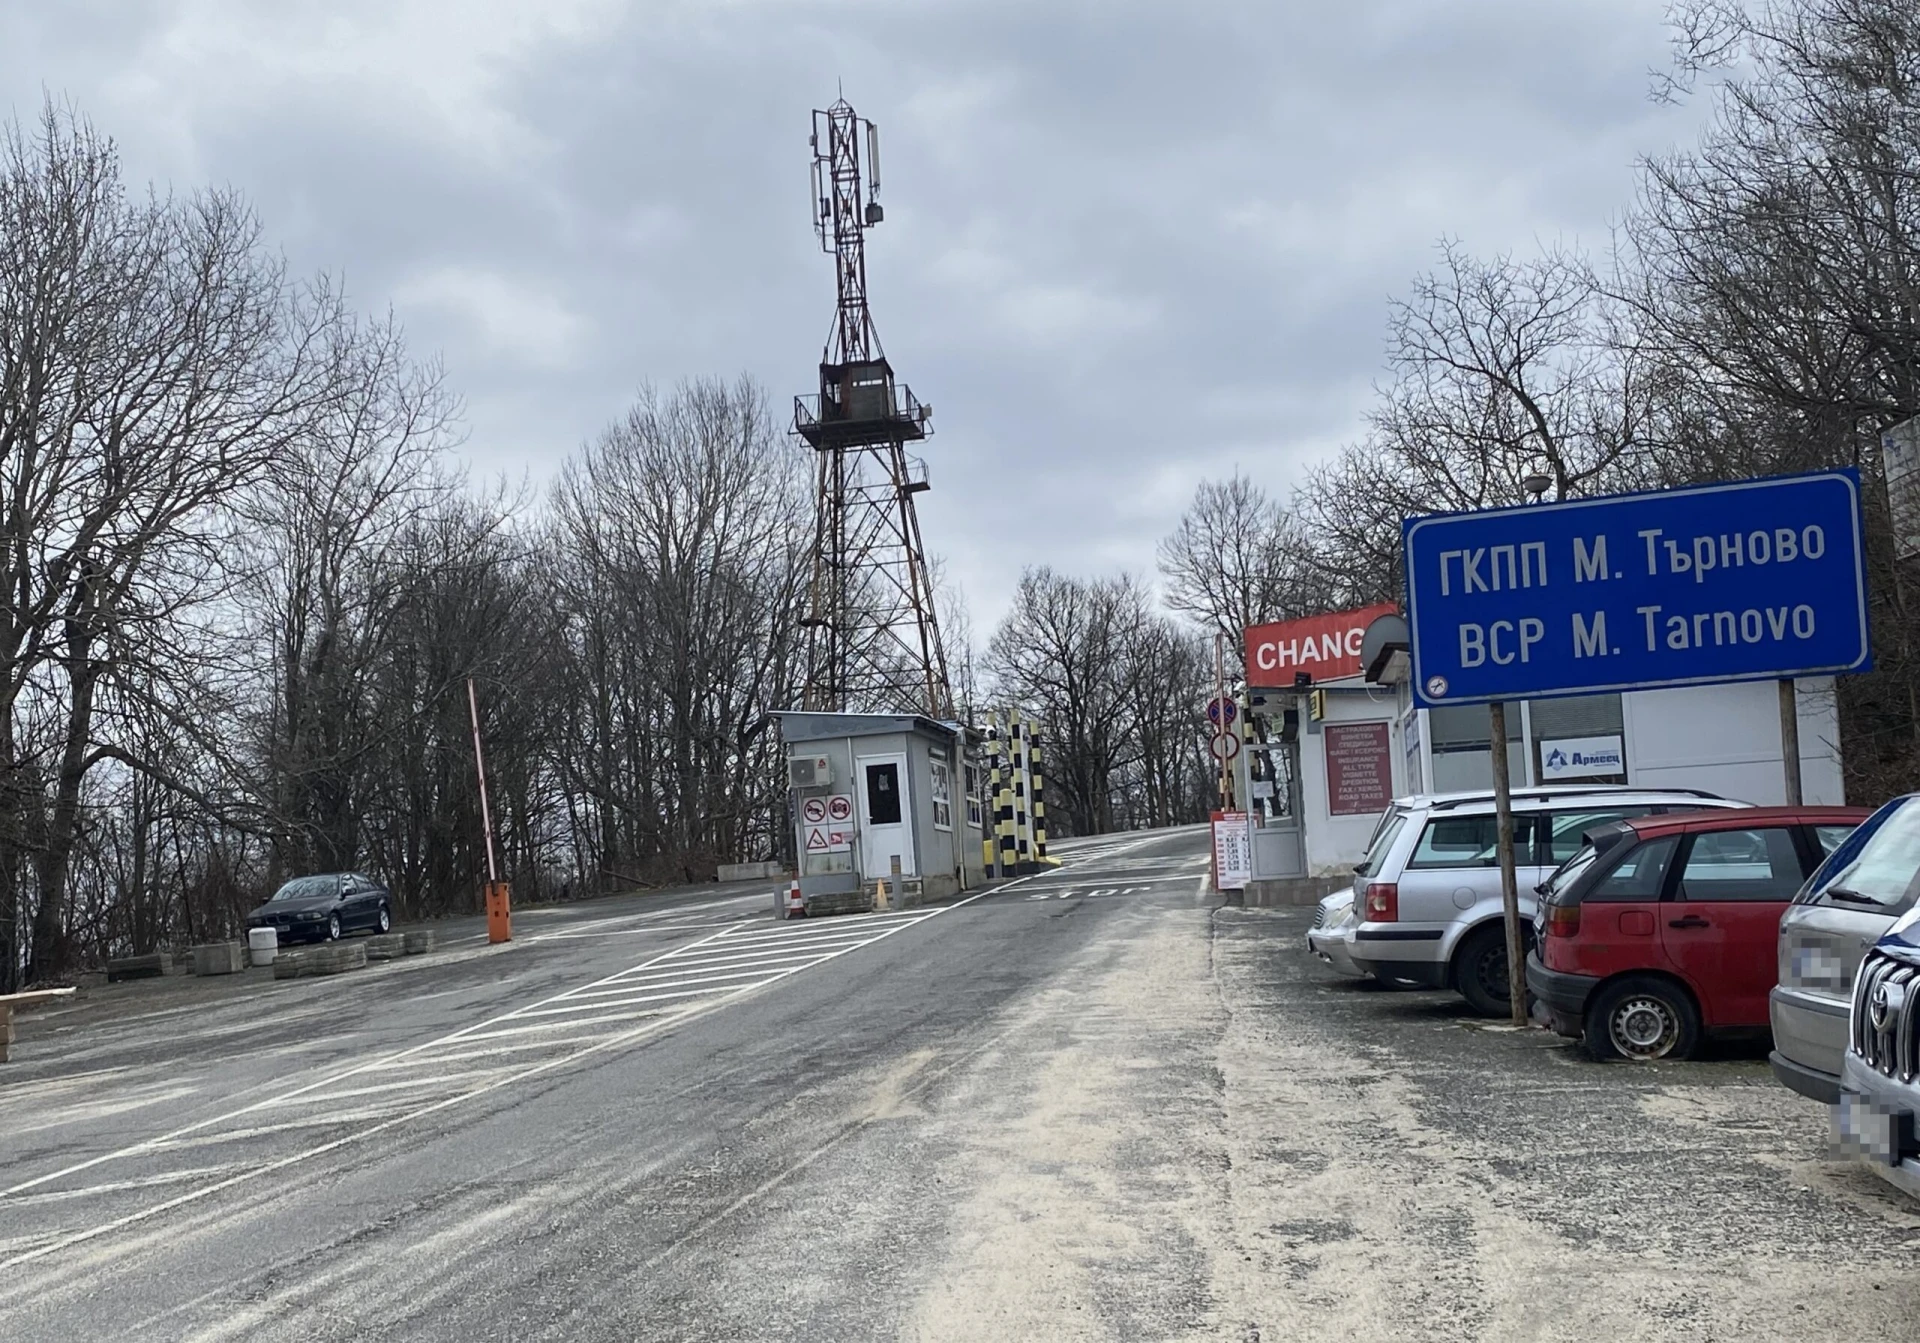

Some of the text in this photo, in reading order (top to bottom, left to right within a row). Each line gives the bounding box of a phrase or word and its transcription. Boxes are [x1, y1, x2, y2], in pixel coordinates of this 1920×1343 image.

[1440, 525, 1825, 596] ГКПП М. Търново
[1459, 604, 1815, 668] BCP M. Tarnovo
[1338, 755, 1380, 764] INSURANCE
[1342, 770, 1377, 778] VIGNETTE
[1341, 777, 1379, 786] SPEDITION
[1339, 792, 1384, 801] ROAD TAXES
